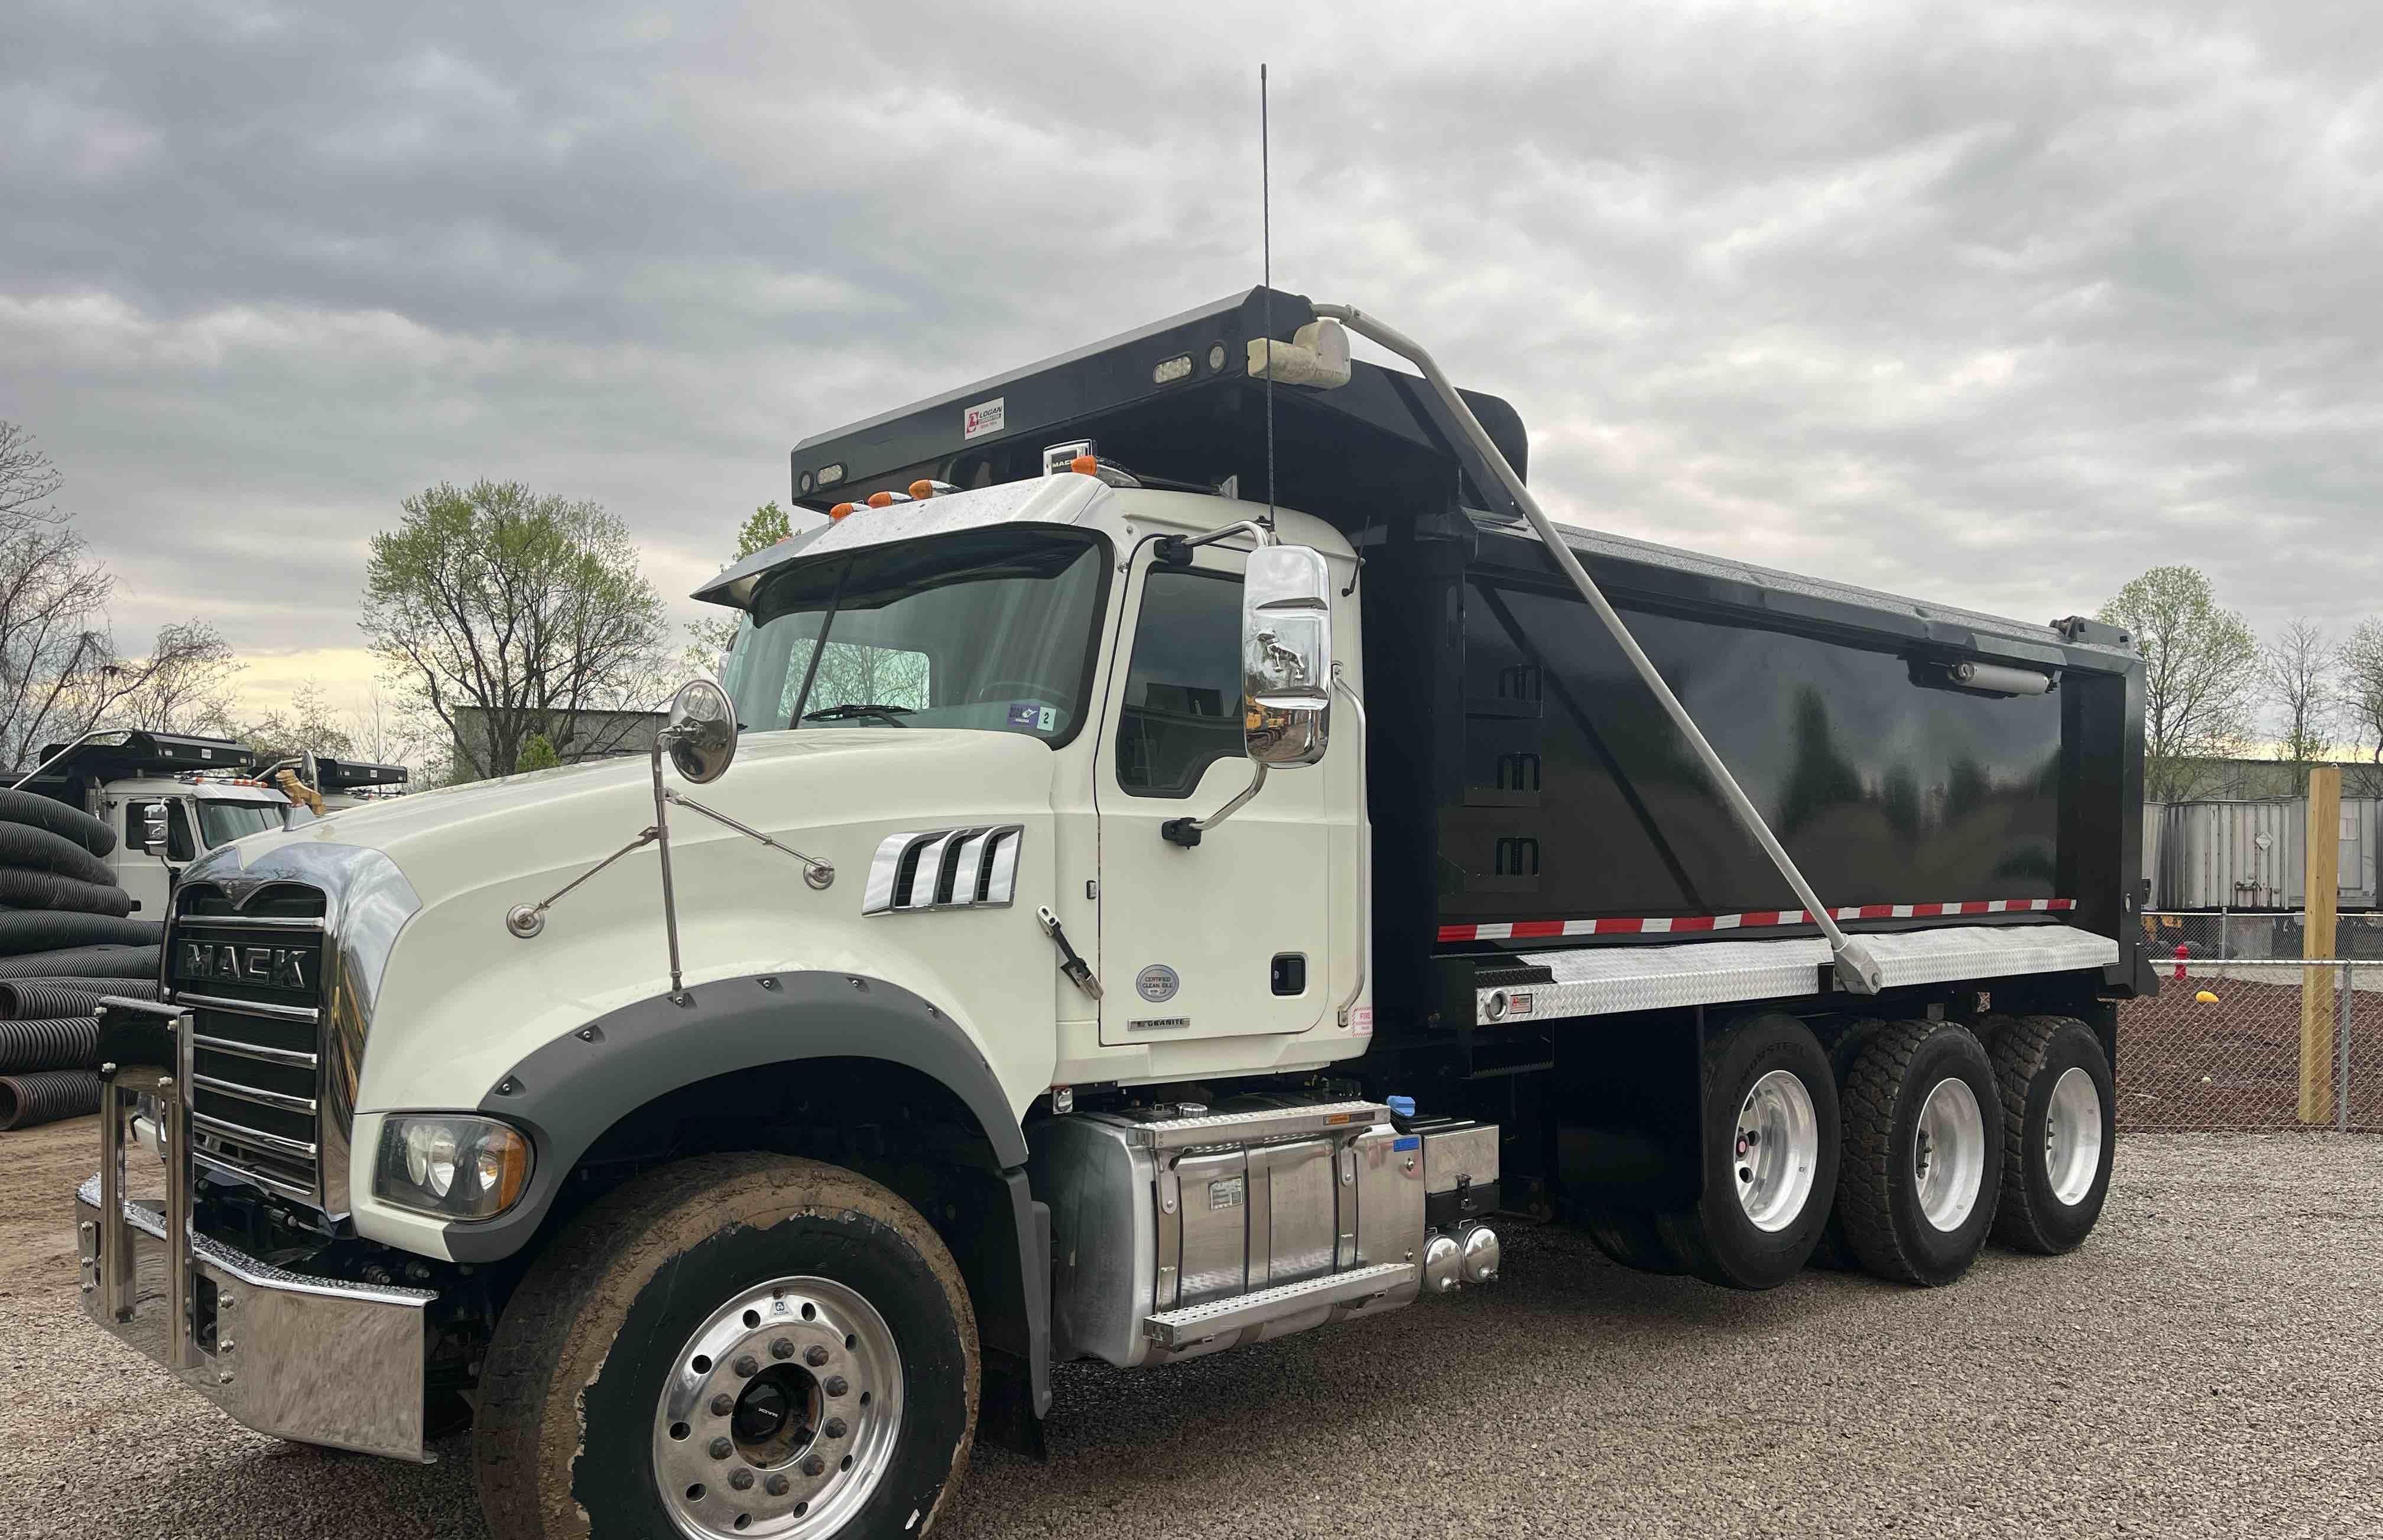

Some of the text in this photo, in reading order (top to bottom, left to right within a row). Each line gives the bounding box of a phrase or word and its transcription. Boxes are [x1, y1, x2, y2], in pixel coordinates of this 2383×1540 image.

[980, 406, 1002, 418] LOGAN
[1044, 712, 1049, 724] 2
[184, 944, 307, 989] MACK
[1147, 1018, 1184, 1027] GRANITE
